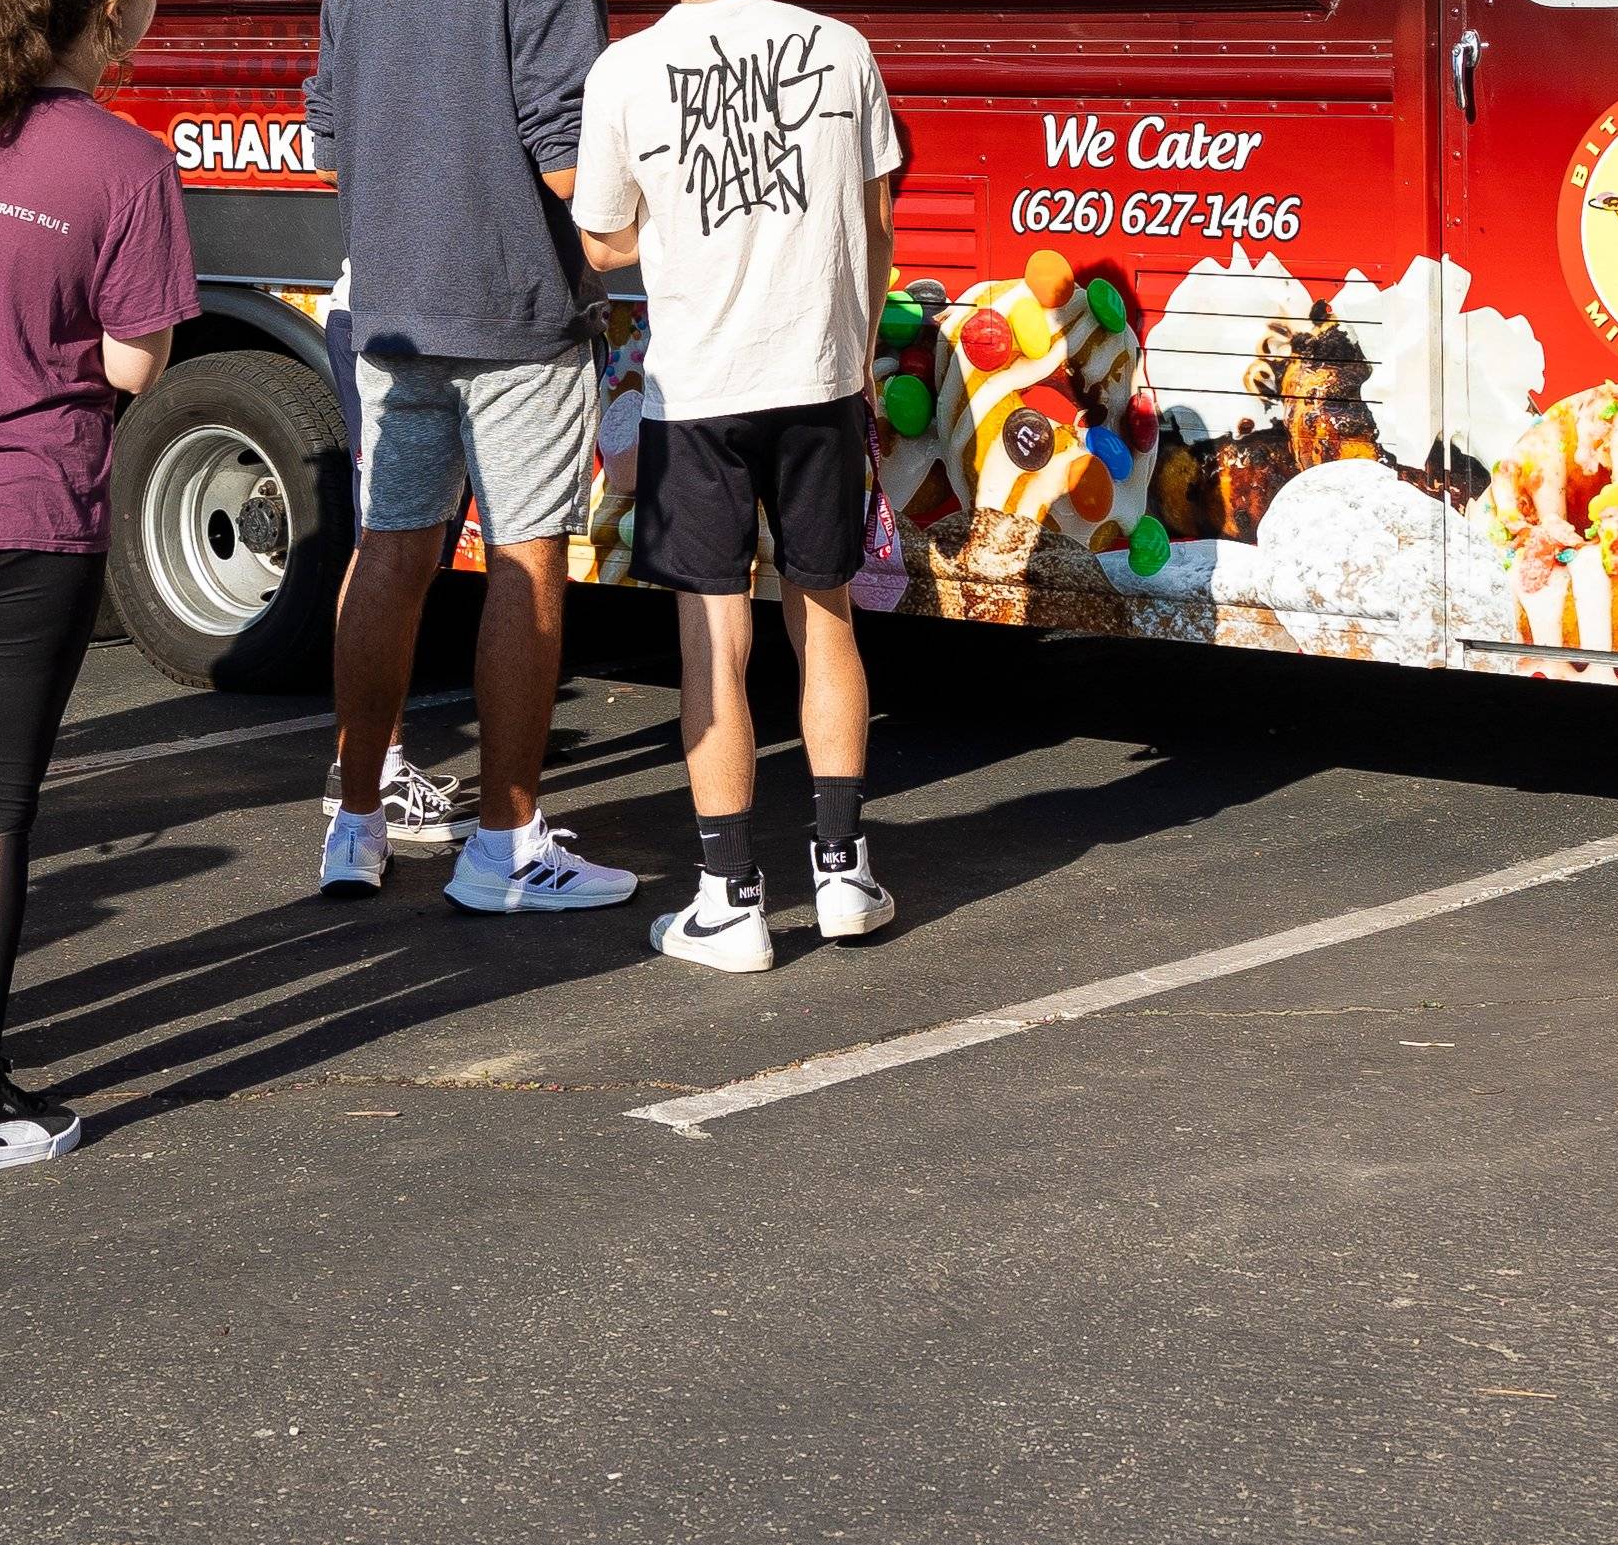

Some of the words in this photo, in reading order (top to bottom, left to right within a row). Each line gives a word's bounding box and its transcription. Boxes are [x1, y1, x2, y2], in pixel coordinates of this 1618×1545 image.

[1043, 114, 1116, 169] We
[1126, 114, 1263, 171] Cater
[1010, 189, 1115, 237] (626)
[1120, 190, 1302, 241] 627-1466
[821, 851, 847, 864] NIKE
[738, 884, 761, 899] NIKE
